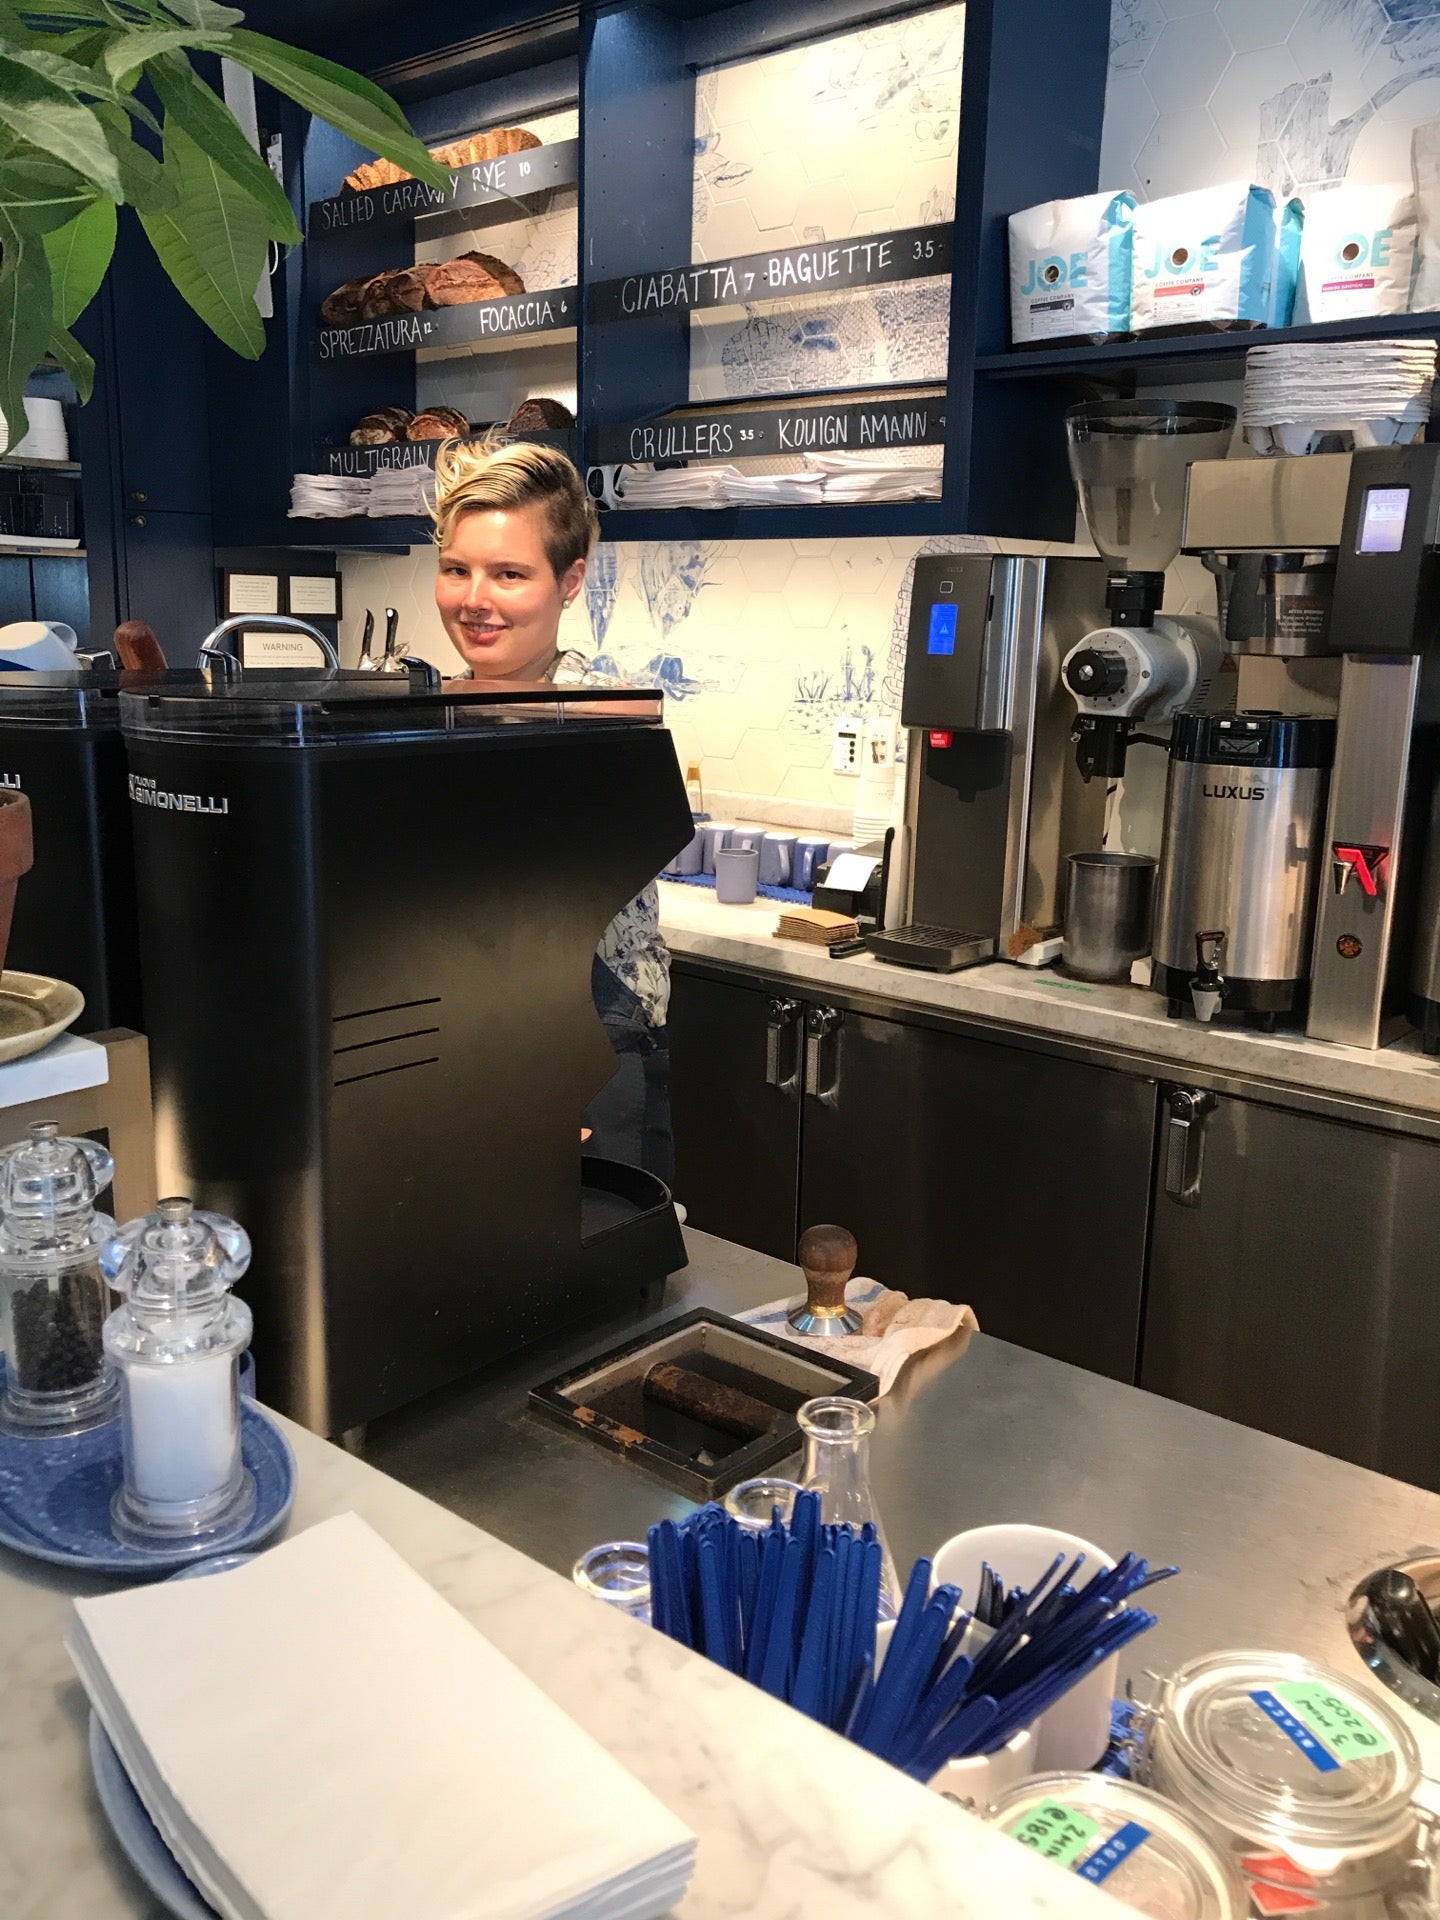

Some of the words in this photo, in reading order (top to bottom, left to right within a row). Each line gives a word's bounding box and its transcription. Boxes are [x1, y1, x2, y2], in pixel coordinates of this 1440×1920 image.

[321, 195, 375, 230] SALTED
[383, 174, 458, 214] CARAWY
[472, 160, 507, 193] RYE
[519, 161, 531, 177] 10
[1143, 235, 1221, 279] JOE
[1335, 229, 1393, 270] OE
[622, 265, 737, 313] CIABATTA
[744, 273, 755, 291] 7
[768, 240, 893, 287] BAGUETTE
[912, 240, 934, 260] 3.5
[1020, 252, 1088, 296] JOE
[320, 316, 422, 359] SPREZZATURA
[423, 322, 433, 334] 12
[480, 301, 555, 334] FOCACCIA
[560, 301, 568, 314] 6
[630, 423, 733, 461] CRULLERS
[778, 415, 848, 450] KOUIGN
[860, 411, 928, 444] AMANN
[329, 444, 431, 477] MULTIGRAIN
[262, 643, 304, 652] WARNING
[135, 787, 229, 814] SIMONELLI
[1202, 785, 1265, 801] LUXUS
